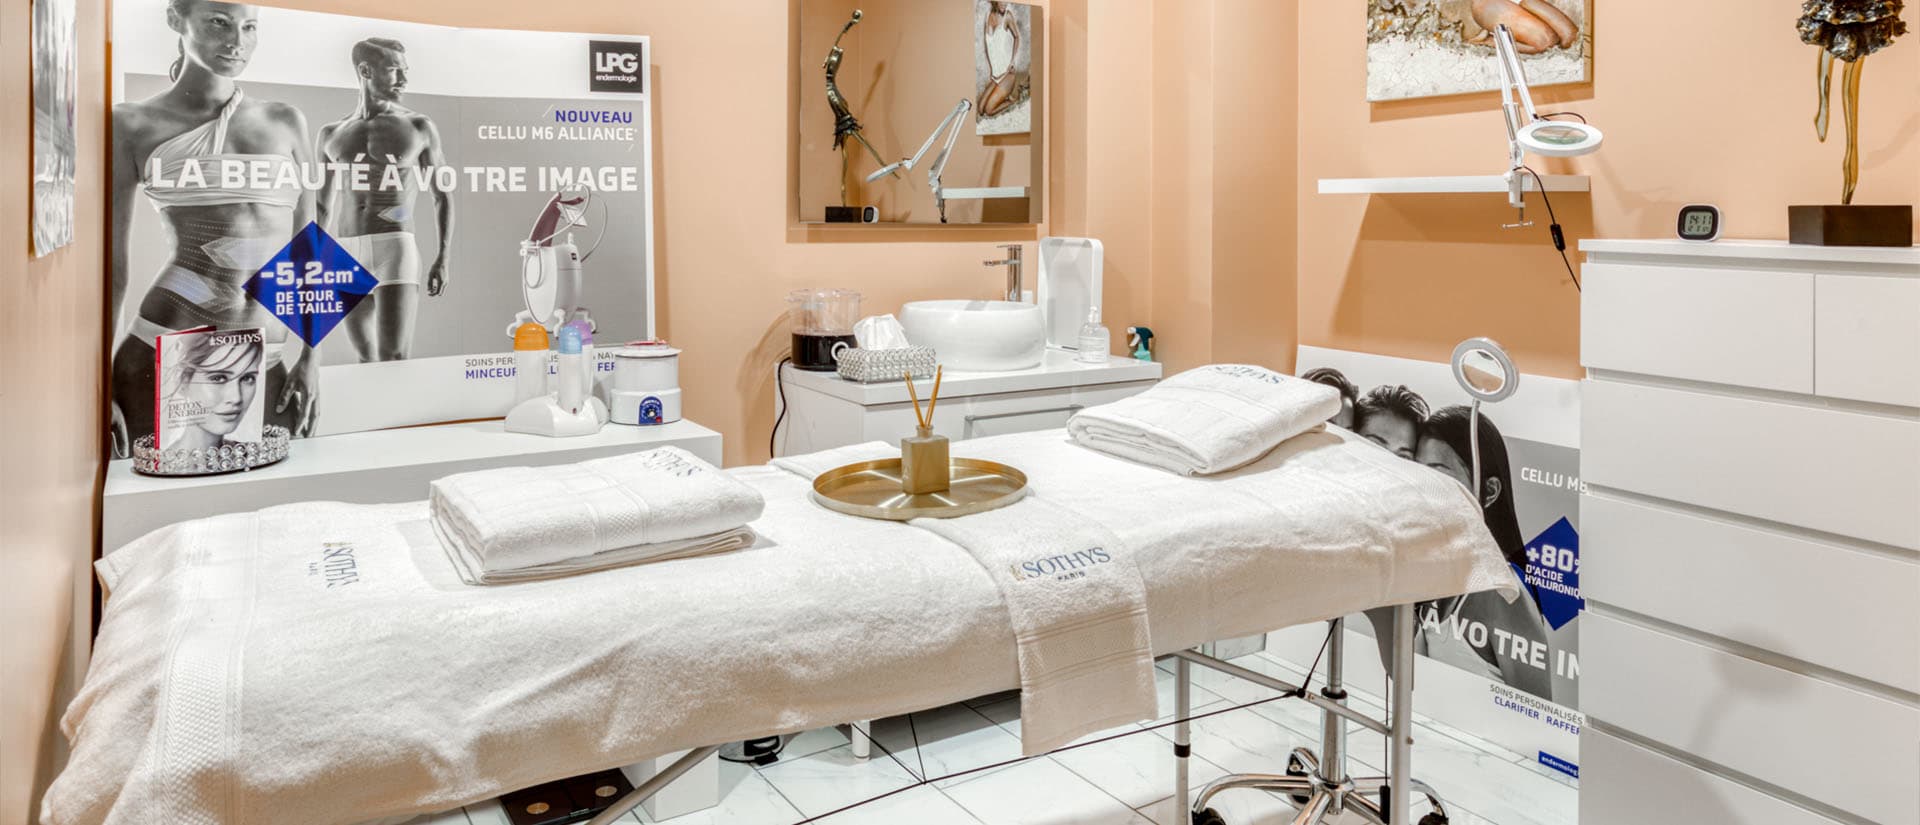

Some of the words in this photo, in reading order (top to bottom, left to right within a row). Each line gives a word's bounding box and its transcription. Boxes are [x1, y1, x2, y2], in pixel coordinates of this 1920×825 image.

[595, 52, 638, 73] LPG
[595, 74, 637, 83] endermologie
[555, 110, 632, 123] NOUVEAU
[478, 125, 527, 140] CELLU
[531, 126, 554, 140] M6
[152, 157, 208, 189] LA
[221, 153, 371, 191] BEAUTÉ
[378, 154, 404, 191] À
[538, 166, 638, 192] IMAGE
[275, 291, 295, 304] DE
[297, 290, 334, 303] TOUR
[275, 304, 295, 315] DE
[297, 301, 344, 314] TAILLE
[215, 333, 261, 346] SOTHYS
[465, 357, 494, 367] SOINS
[1521, 466, 1563, 488] CELLU
[1022, 547, 1111, 578] SOTHYS
[1525, 564, 1564, 583] D'ACIDE
[1524, 574, 1583, 600] HYALURONIQ
[1422, 600, 1441, 634] À
[1490, 684, 1514, 699] SOINS
[1494, 695, 1540, 720] CLARIFIER
